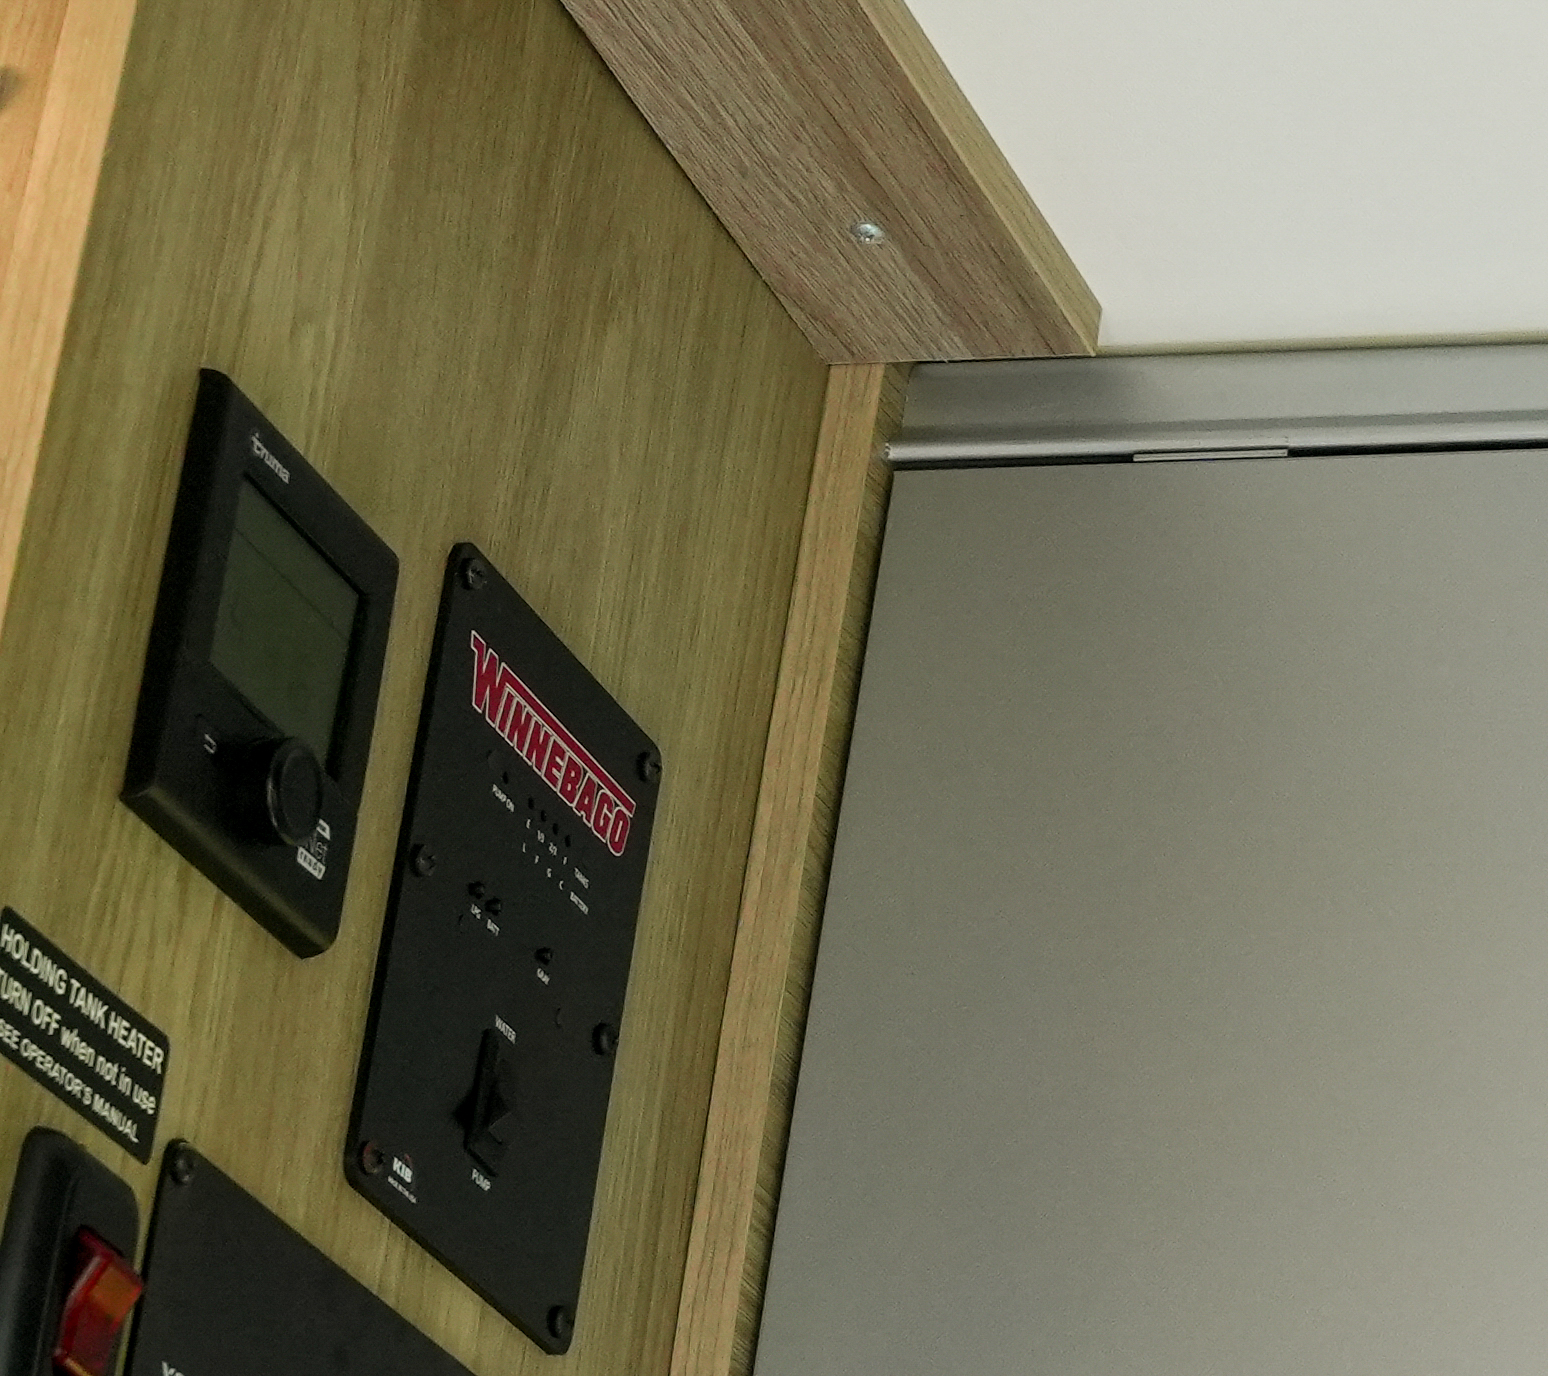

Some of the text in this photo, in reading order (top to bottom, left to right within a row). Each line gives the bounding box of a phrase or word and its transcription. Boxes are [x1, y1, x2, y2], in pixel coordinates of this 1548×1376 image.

[251, 431, 292, 485] truma
[470, 629, 637, 857] WINNEBAGO
[0, 923, 164, 1075] HOLDING TANK HEATER
[494, 1013, 517, 1045] WATER
[20, 1038, 93, 1106] OPERATOR'S
[92, 1092, 140, 1144] MANUAL
[31, 998, 62, 1036] OFF
[61, 1026, 96, 1068] when
[95, 1055, 119, 1088] not
[118, 1066, 133, 1097] in
[132, 1084, 157, 1115] use
